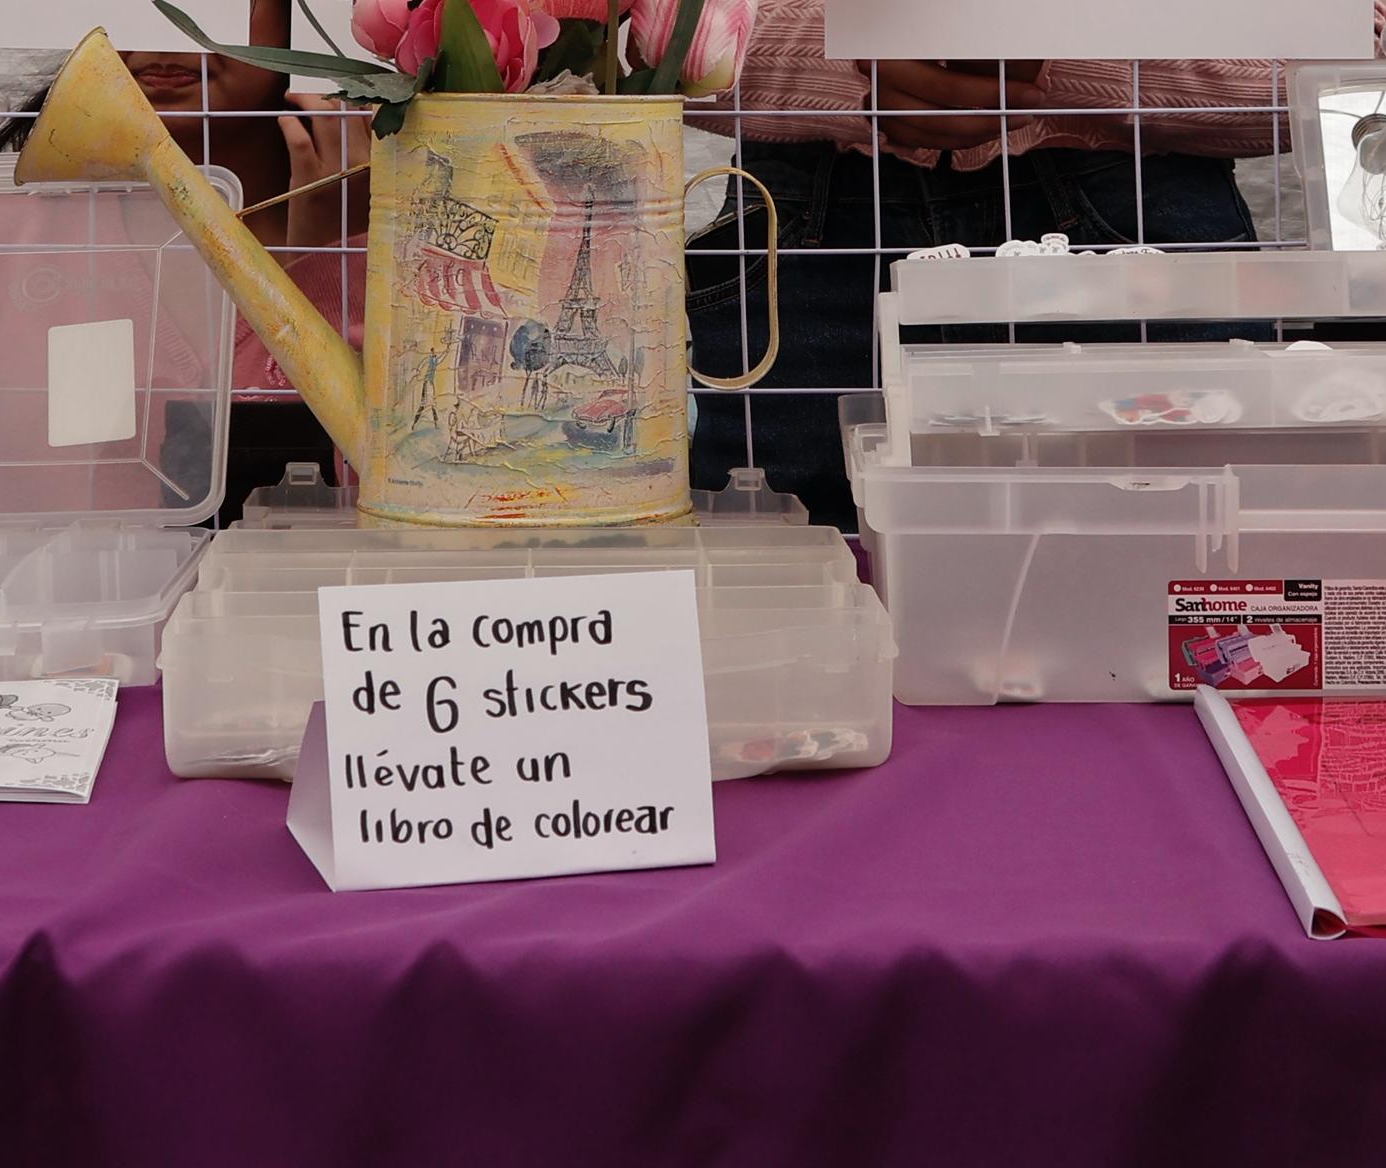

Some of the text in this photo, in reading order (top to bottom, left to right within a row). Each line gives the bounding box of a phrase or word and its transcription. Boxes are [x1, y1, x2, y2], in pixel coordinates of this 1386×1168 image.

[1175, 597, 1247, 612] Sanhome
[341, 610, 613, 655] En la compra
[1174, 673, 1180, 682] 1
[352, 670, 653, 733] de 6 stickers
[344, 746, 572, 791] llévate un
[359, 799, 675, 849] libro de colorear
